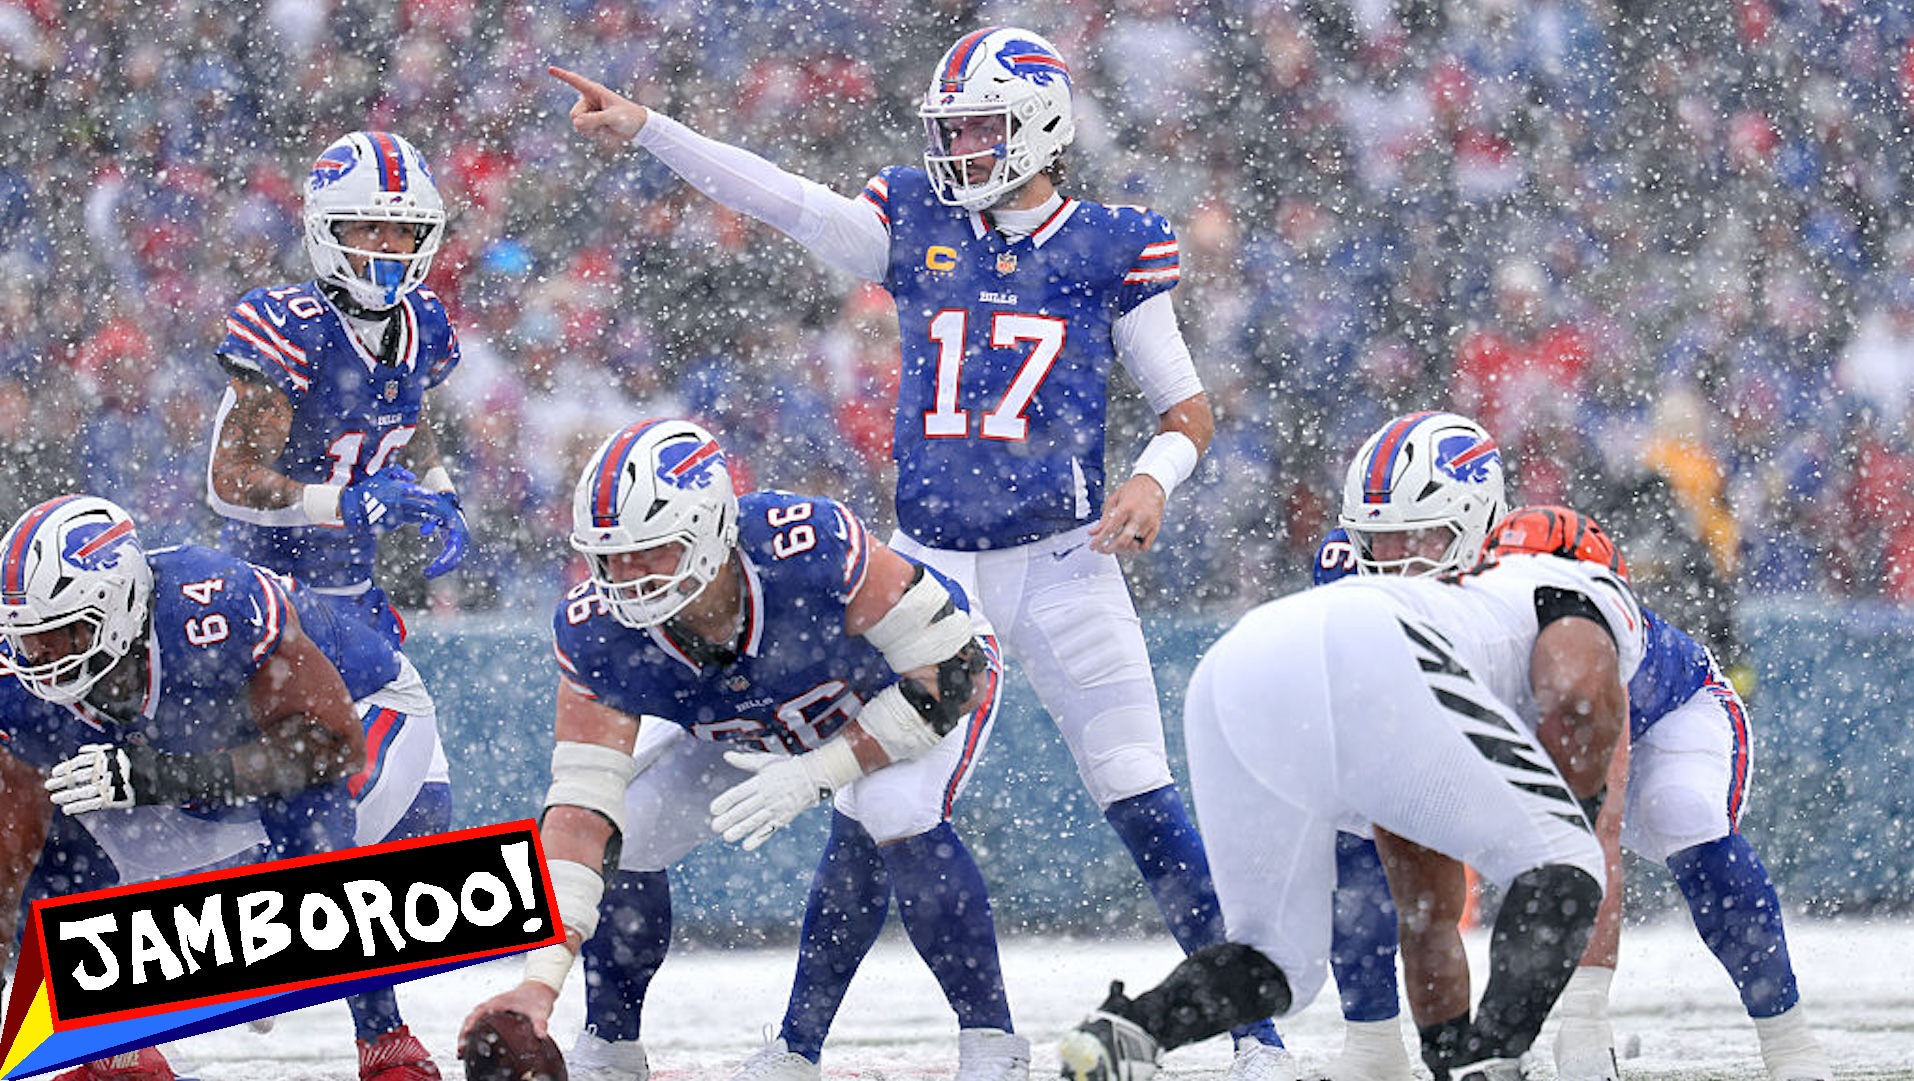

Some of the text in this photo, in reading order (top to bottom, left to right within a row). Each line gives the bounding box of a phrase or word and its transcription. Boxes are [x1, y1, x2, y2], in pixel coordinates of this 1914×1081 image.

[925, 245, 957, 271] C
[266, 285, 325, 320] 10
[979, 291, 1018, 305] BILLS
[924, 308, 1067, 441] 17
[766, 502, 818, 560] 66
[182, 578, 231, 646] 64
